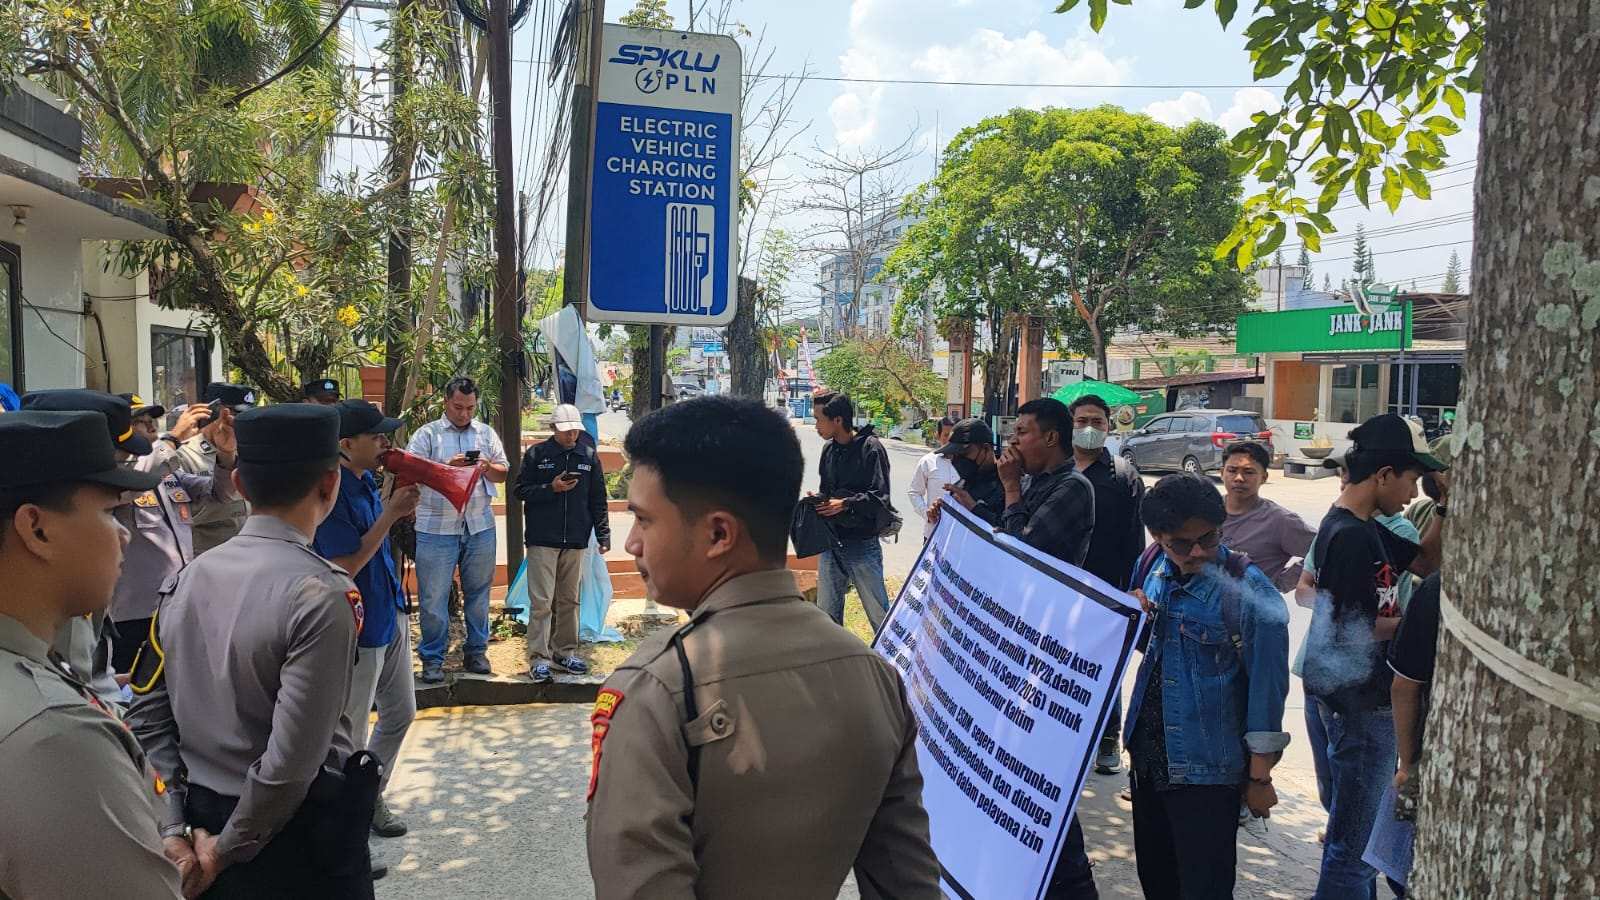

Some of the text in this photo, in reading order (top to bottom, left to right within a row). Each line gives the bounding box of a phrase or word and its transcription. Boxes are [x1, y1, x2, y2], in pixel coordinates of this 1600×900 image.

[609, 44, 720, 73] SPKLU
[666, 72, 716, 94] PLN
[620, 117, 718, 140] ELECTRIC
[632, 138, 716, 160] VEHICLE
[607, 157, 716, 180] CHARGING
[629, 180, 715, 200] STATION
[1330, 312, 1402, 335] JANK JANK
[980, 594, 1016, 629] jabatannya
[1013, 616, 1041, 646] karena
[1040, 633, 1073, 666] diduga
[1070, 652, 1103, 682] kuat
[997, 636, 1027, 667] pemilik
[963, 664, 978, 687] Istri
[974, 674, 1006, 712] Gubernur
[1003, 698, 1035, 734] Kaltim
[972, 641, 991, 669] Senin
[1047, 700, 1083, 733] untuk
[955, 705, 974, 733] ESDM
[971, 724, 995, 755] segera
[994, 745, 1062, 802] menurunkan
[955, 770, 979, 803] dalam
[976, 791, 1021, 838] pelayana
[1019, 824, 1044, 854] izin
[992, 773, 1012, 800] dan
[1011, 788, 1052, 829] diduga
